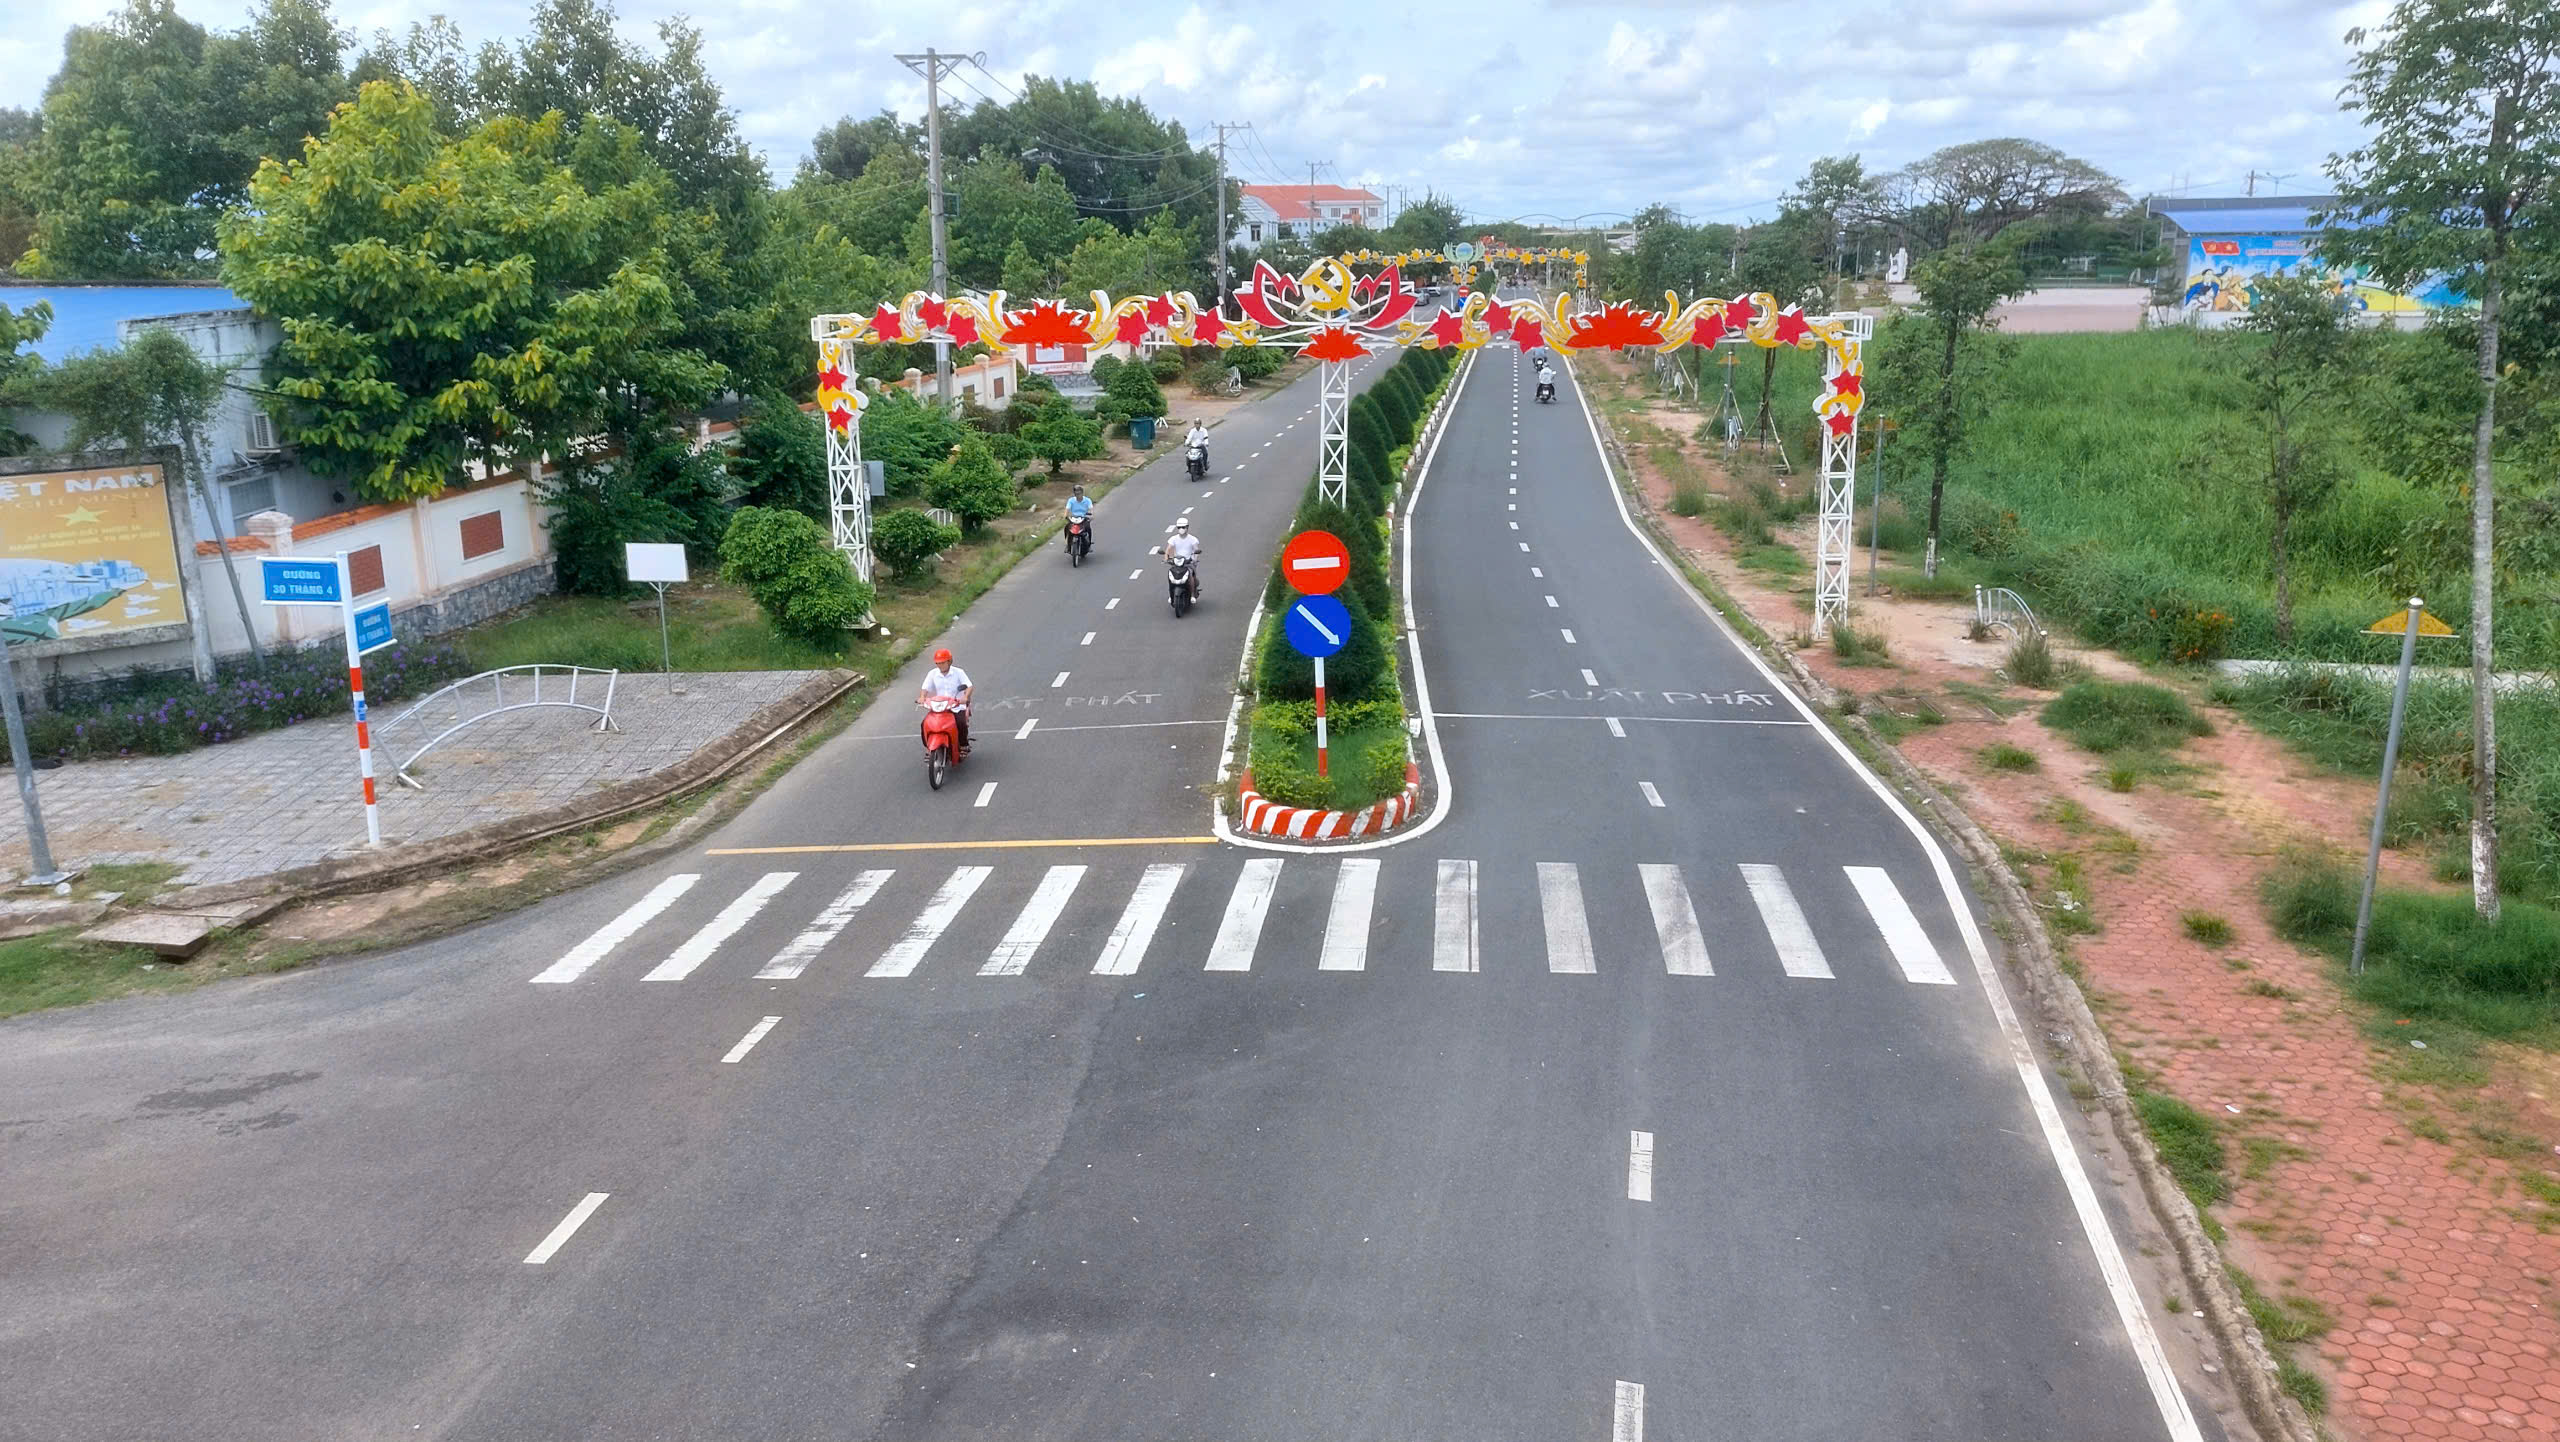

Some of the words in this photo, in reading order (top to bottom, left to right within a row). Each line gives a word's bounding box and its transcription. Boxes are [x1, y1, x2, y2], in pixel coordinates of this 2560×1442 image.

[65, 473, 153, 494] NAM
[273, 584, 286, 594] 30
[326, 585, 333, 595] 4
[1065, 690, 1162, 707] PHÁT
[1662, 689, 1774, 706] PHÁT
